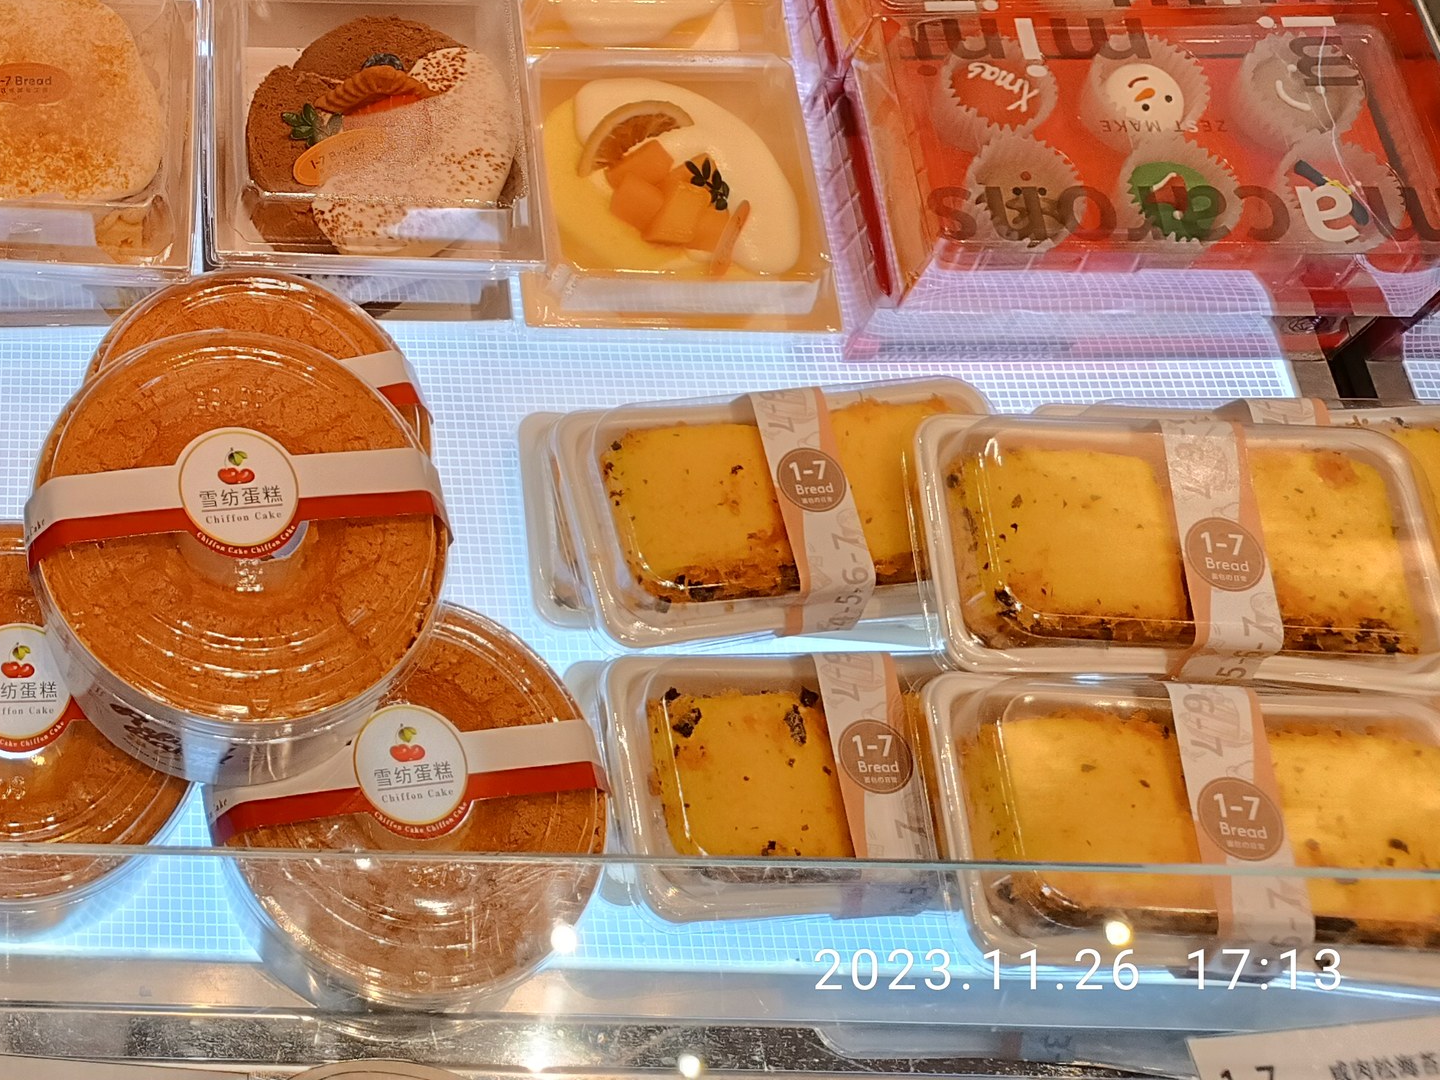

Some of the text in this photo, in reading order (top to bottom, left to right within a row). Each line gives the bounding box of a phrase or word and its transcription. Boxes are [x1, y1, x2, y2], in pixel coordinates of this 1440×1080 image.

[15, 75, 52, 87] Bread
[1101, 120, 1162, 132] MAKE
[789, 460, 826, 481] 1-7
[200, 485, 283, 508] 雪纺蛋糕
[795, 482, 833, 495] Bread
[206, 511, 282, 524] Chiffon Cake
[1200, 531, 1244, 556] 1-7
[1205, 556, 1250, 572] Bread
[29, 706, 54, 715] Cake
[852, 735, 892, 757] 1-7
[374, 761, 454, 787] 雪纺蛋糕
[857, 760, 900, 773] Bread
[381, 788, 454, 803] Chiffon Cake
[1213, 793, 1260, 821] 1-7
[1219, 821, 1268, 839] Bread
